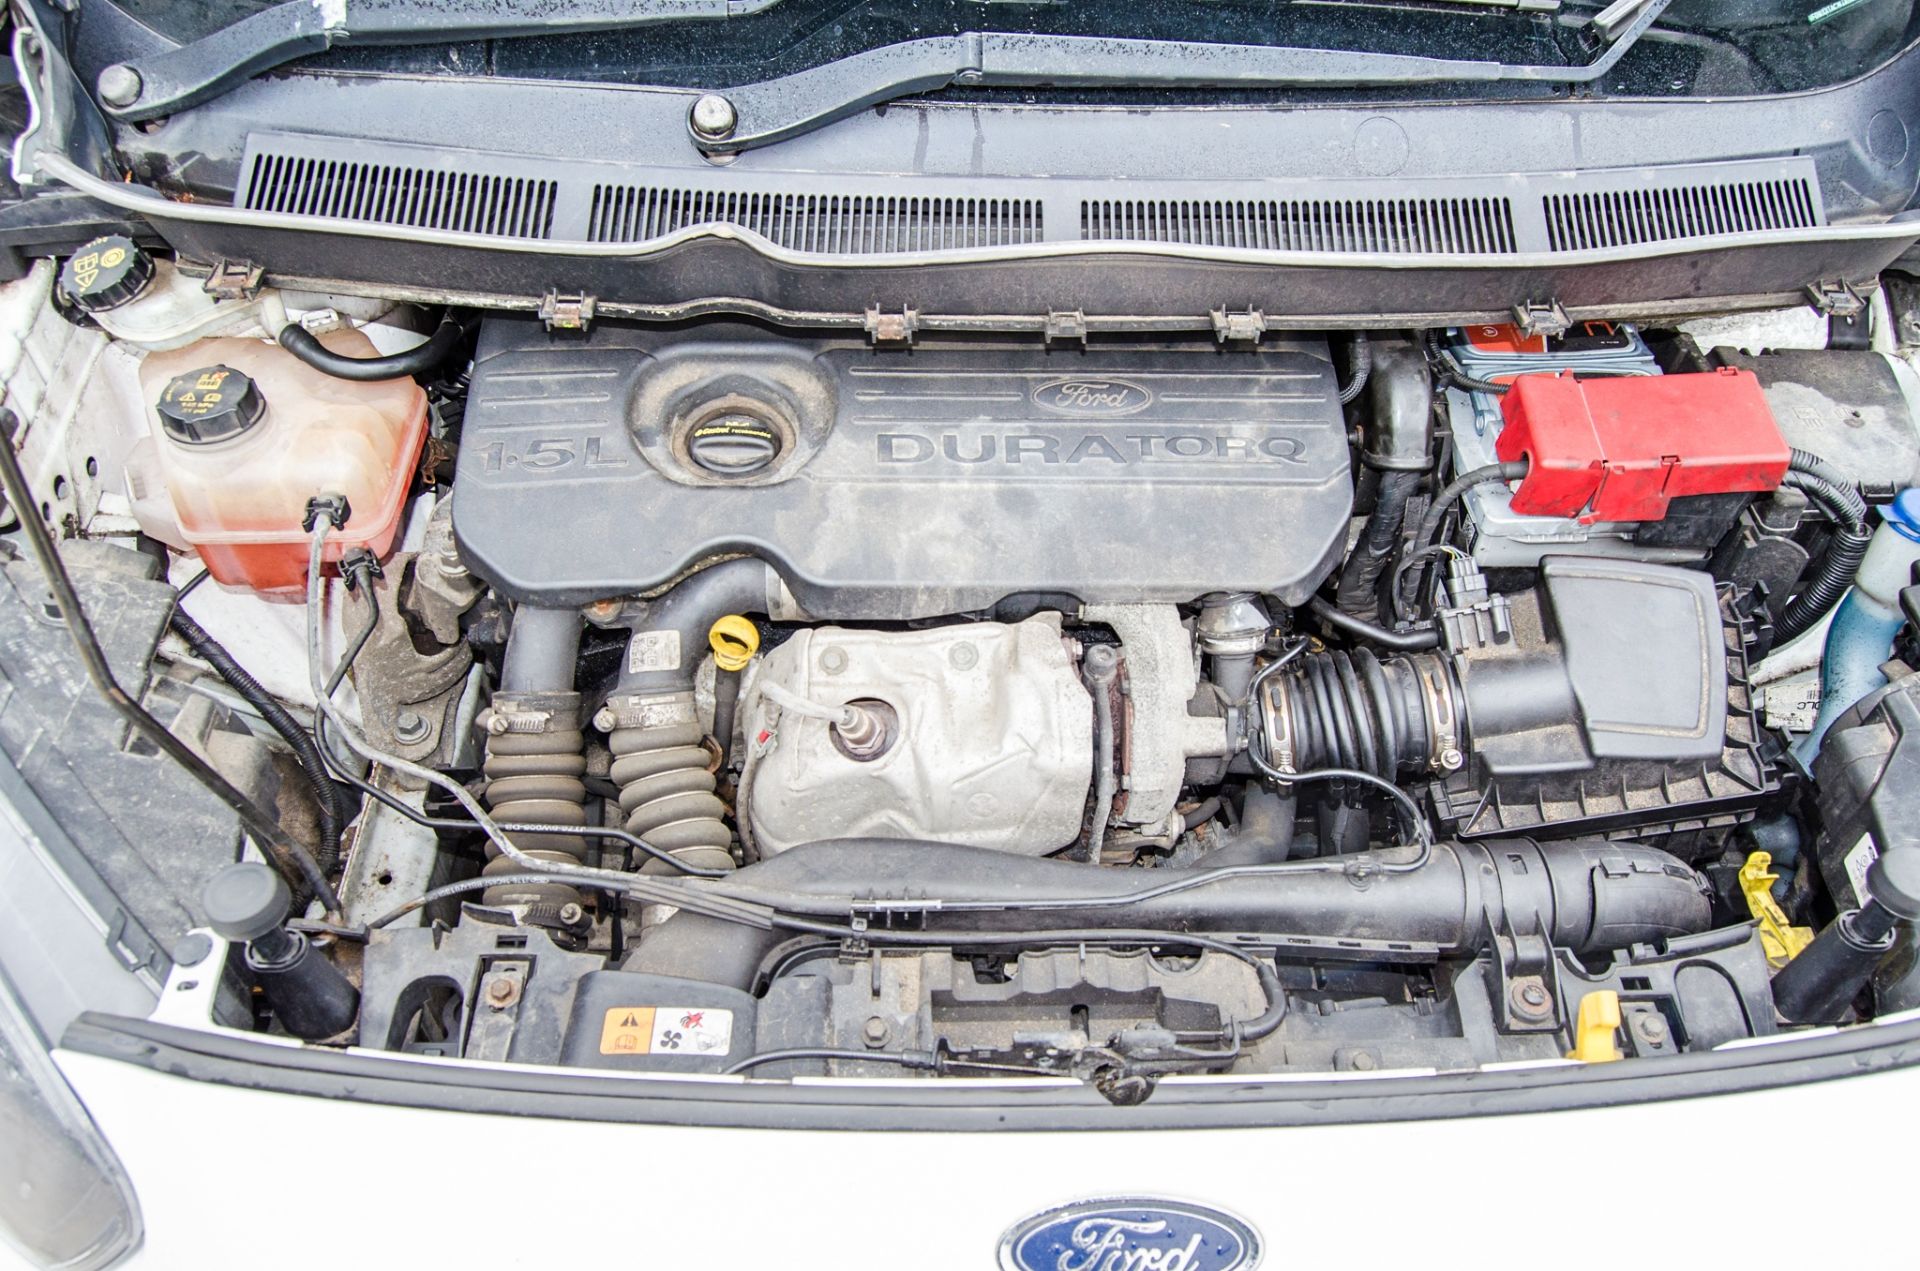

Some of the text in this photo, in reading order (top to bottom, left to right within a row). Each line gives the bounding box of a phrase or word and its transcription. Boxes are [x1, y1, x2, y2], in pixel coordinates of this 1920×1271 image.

[1055, 382, 1131, 409] Ford
[876, 433, 1308, 465] DURATORQ
[1056, 1218, 1202, 1271] Ford
